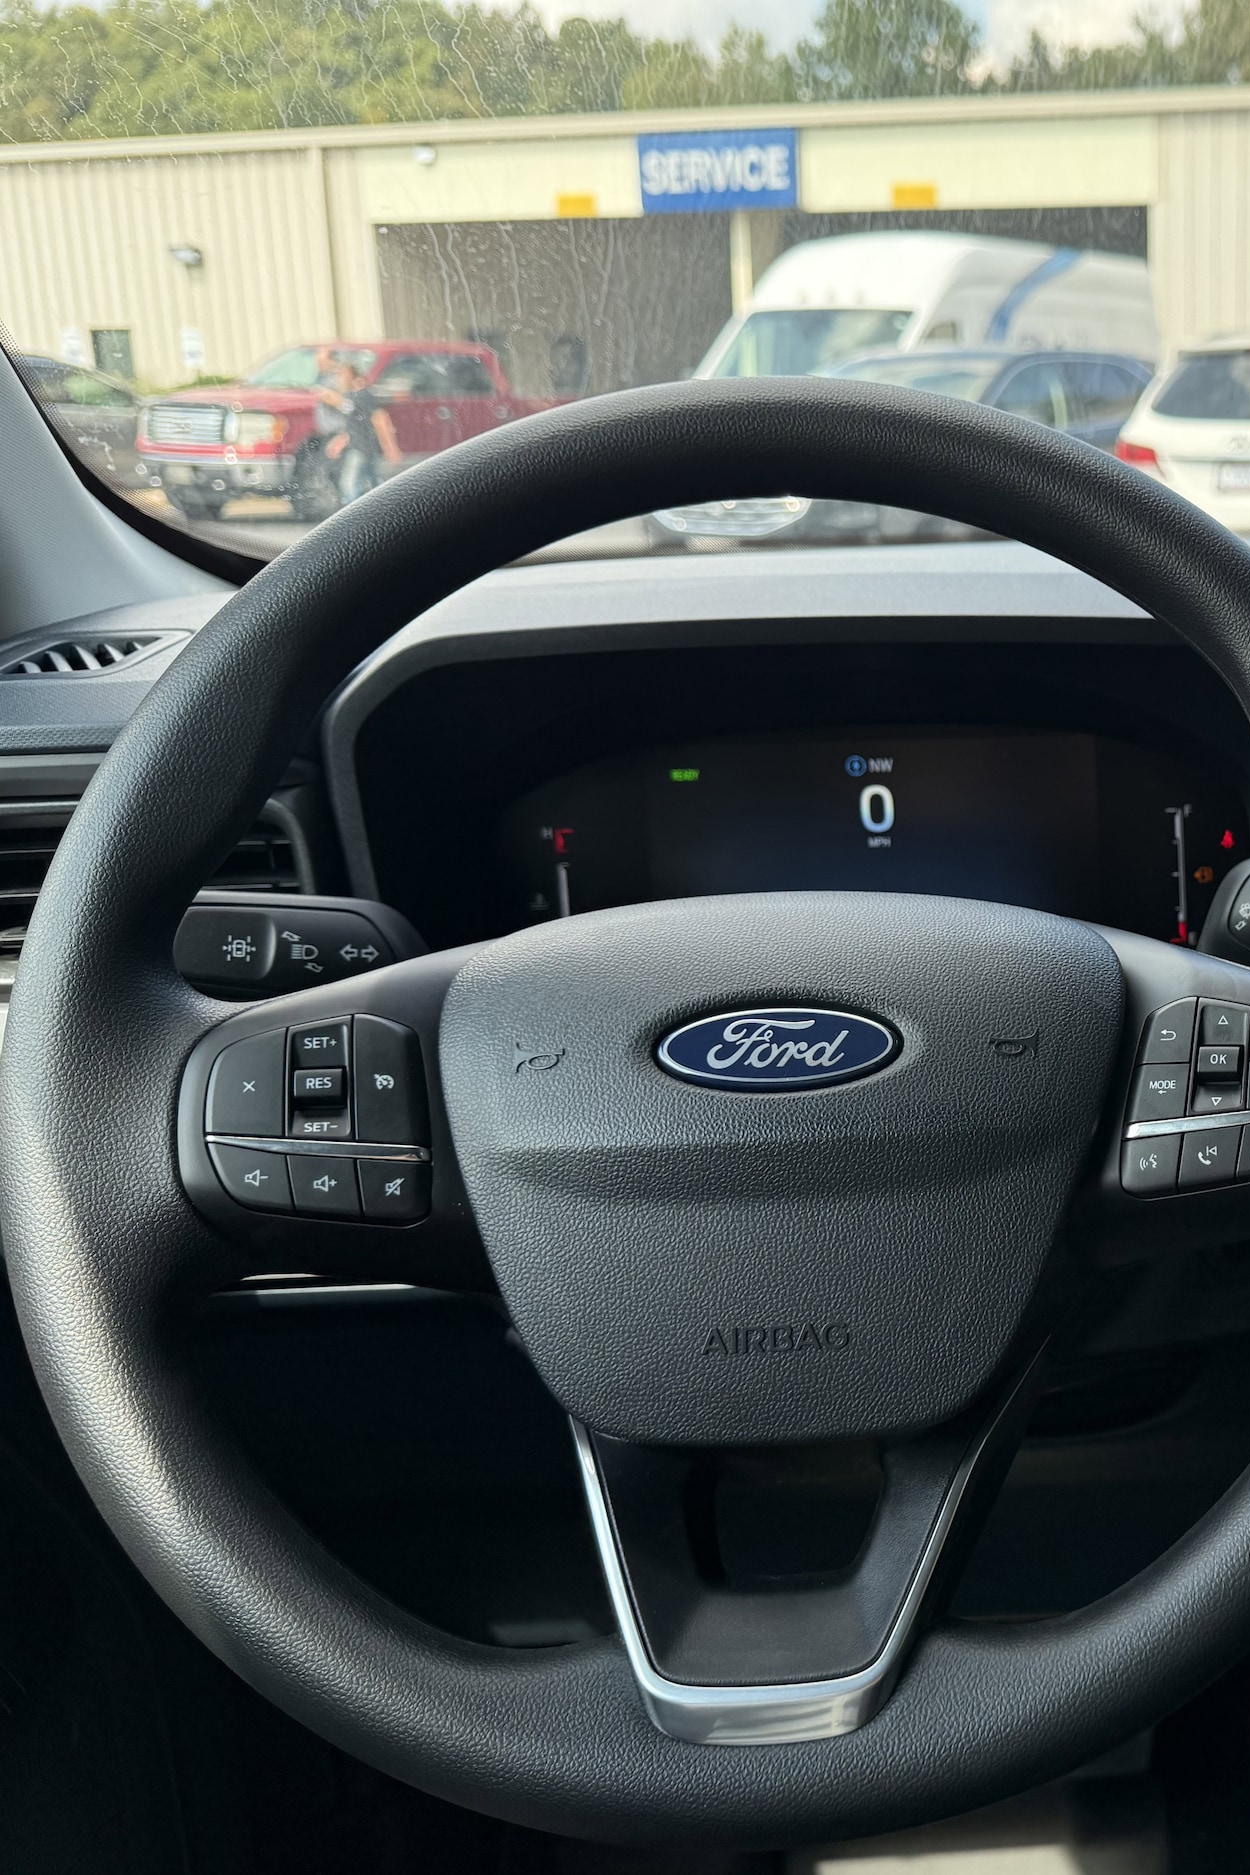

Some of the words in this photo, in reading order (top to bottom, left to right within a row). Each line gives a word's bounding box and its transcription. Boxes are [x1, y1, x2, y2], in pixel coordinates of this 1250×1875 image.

[641, 145, 790, 196] SERVICE
[868, 757, 893, 773] NW
[859, 784, 895, 834] 0
[303, 1036, 338, 1050] SET+
[706, 1017, 846, 1071] Ford
[1209, 1053, 1227, 1065] OK
[305, 1076, 332, 1090] RES
[1149, 1079, 1177, 1090] MODE
[701, 1320, 853, 1356] AIRBAG
